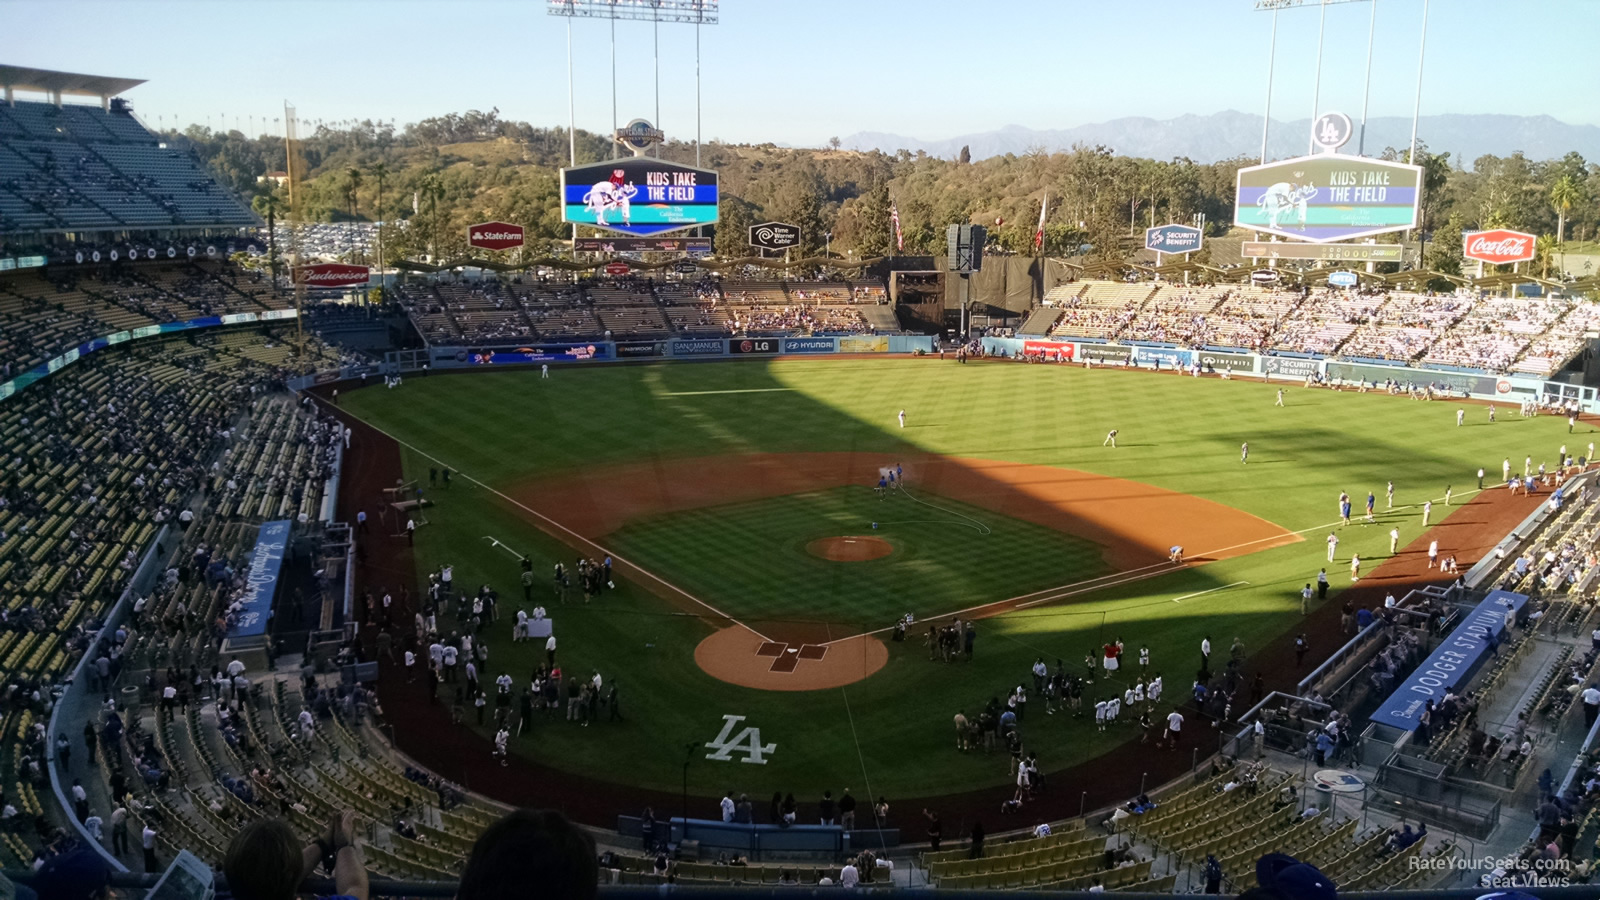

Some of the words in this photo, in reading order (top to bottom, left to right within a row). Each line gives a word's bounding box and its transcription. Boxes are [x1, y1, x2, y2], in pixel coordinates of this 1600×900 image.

[1320, 117, 1339, 143] LA
[646, 171, 669, 186] KIDS
[672, 172, 697, 186] TAKE
[1329, 171, 1357, 186] KIDS
[1362, 171, 1390, 186] TAKE
[647, 186, 667, 201] THE
[668, 186, 695, 201] FIELD
[1329, 186, 1350, 202] THE
[1354, 186, 1387, 202] FIELD
[1166, 231, 1198, 239] SECURITY
[302, 269, 368, 281] Budweiser
[674, 342, 689, 350] SAN
[693, 341, 721, 349] MANUEL
[754, 342, 769, 350] LG
[1216, 359, 1251, 367] INFINITI
[1280, 359, 1316, 369] SECURITY
[1279, 367, 1315, 377] BENEFIT
[1411, 650, 1468, 696] DODGER
[1453, 609, 1505, 650] STADIUM
[704, 714, 777, 765] LA
